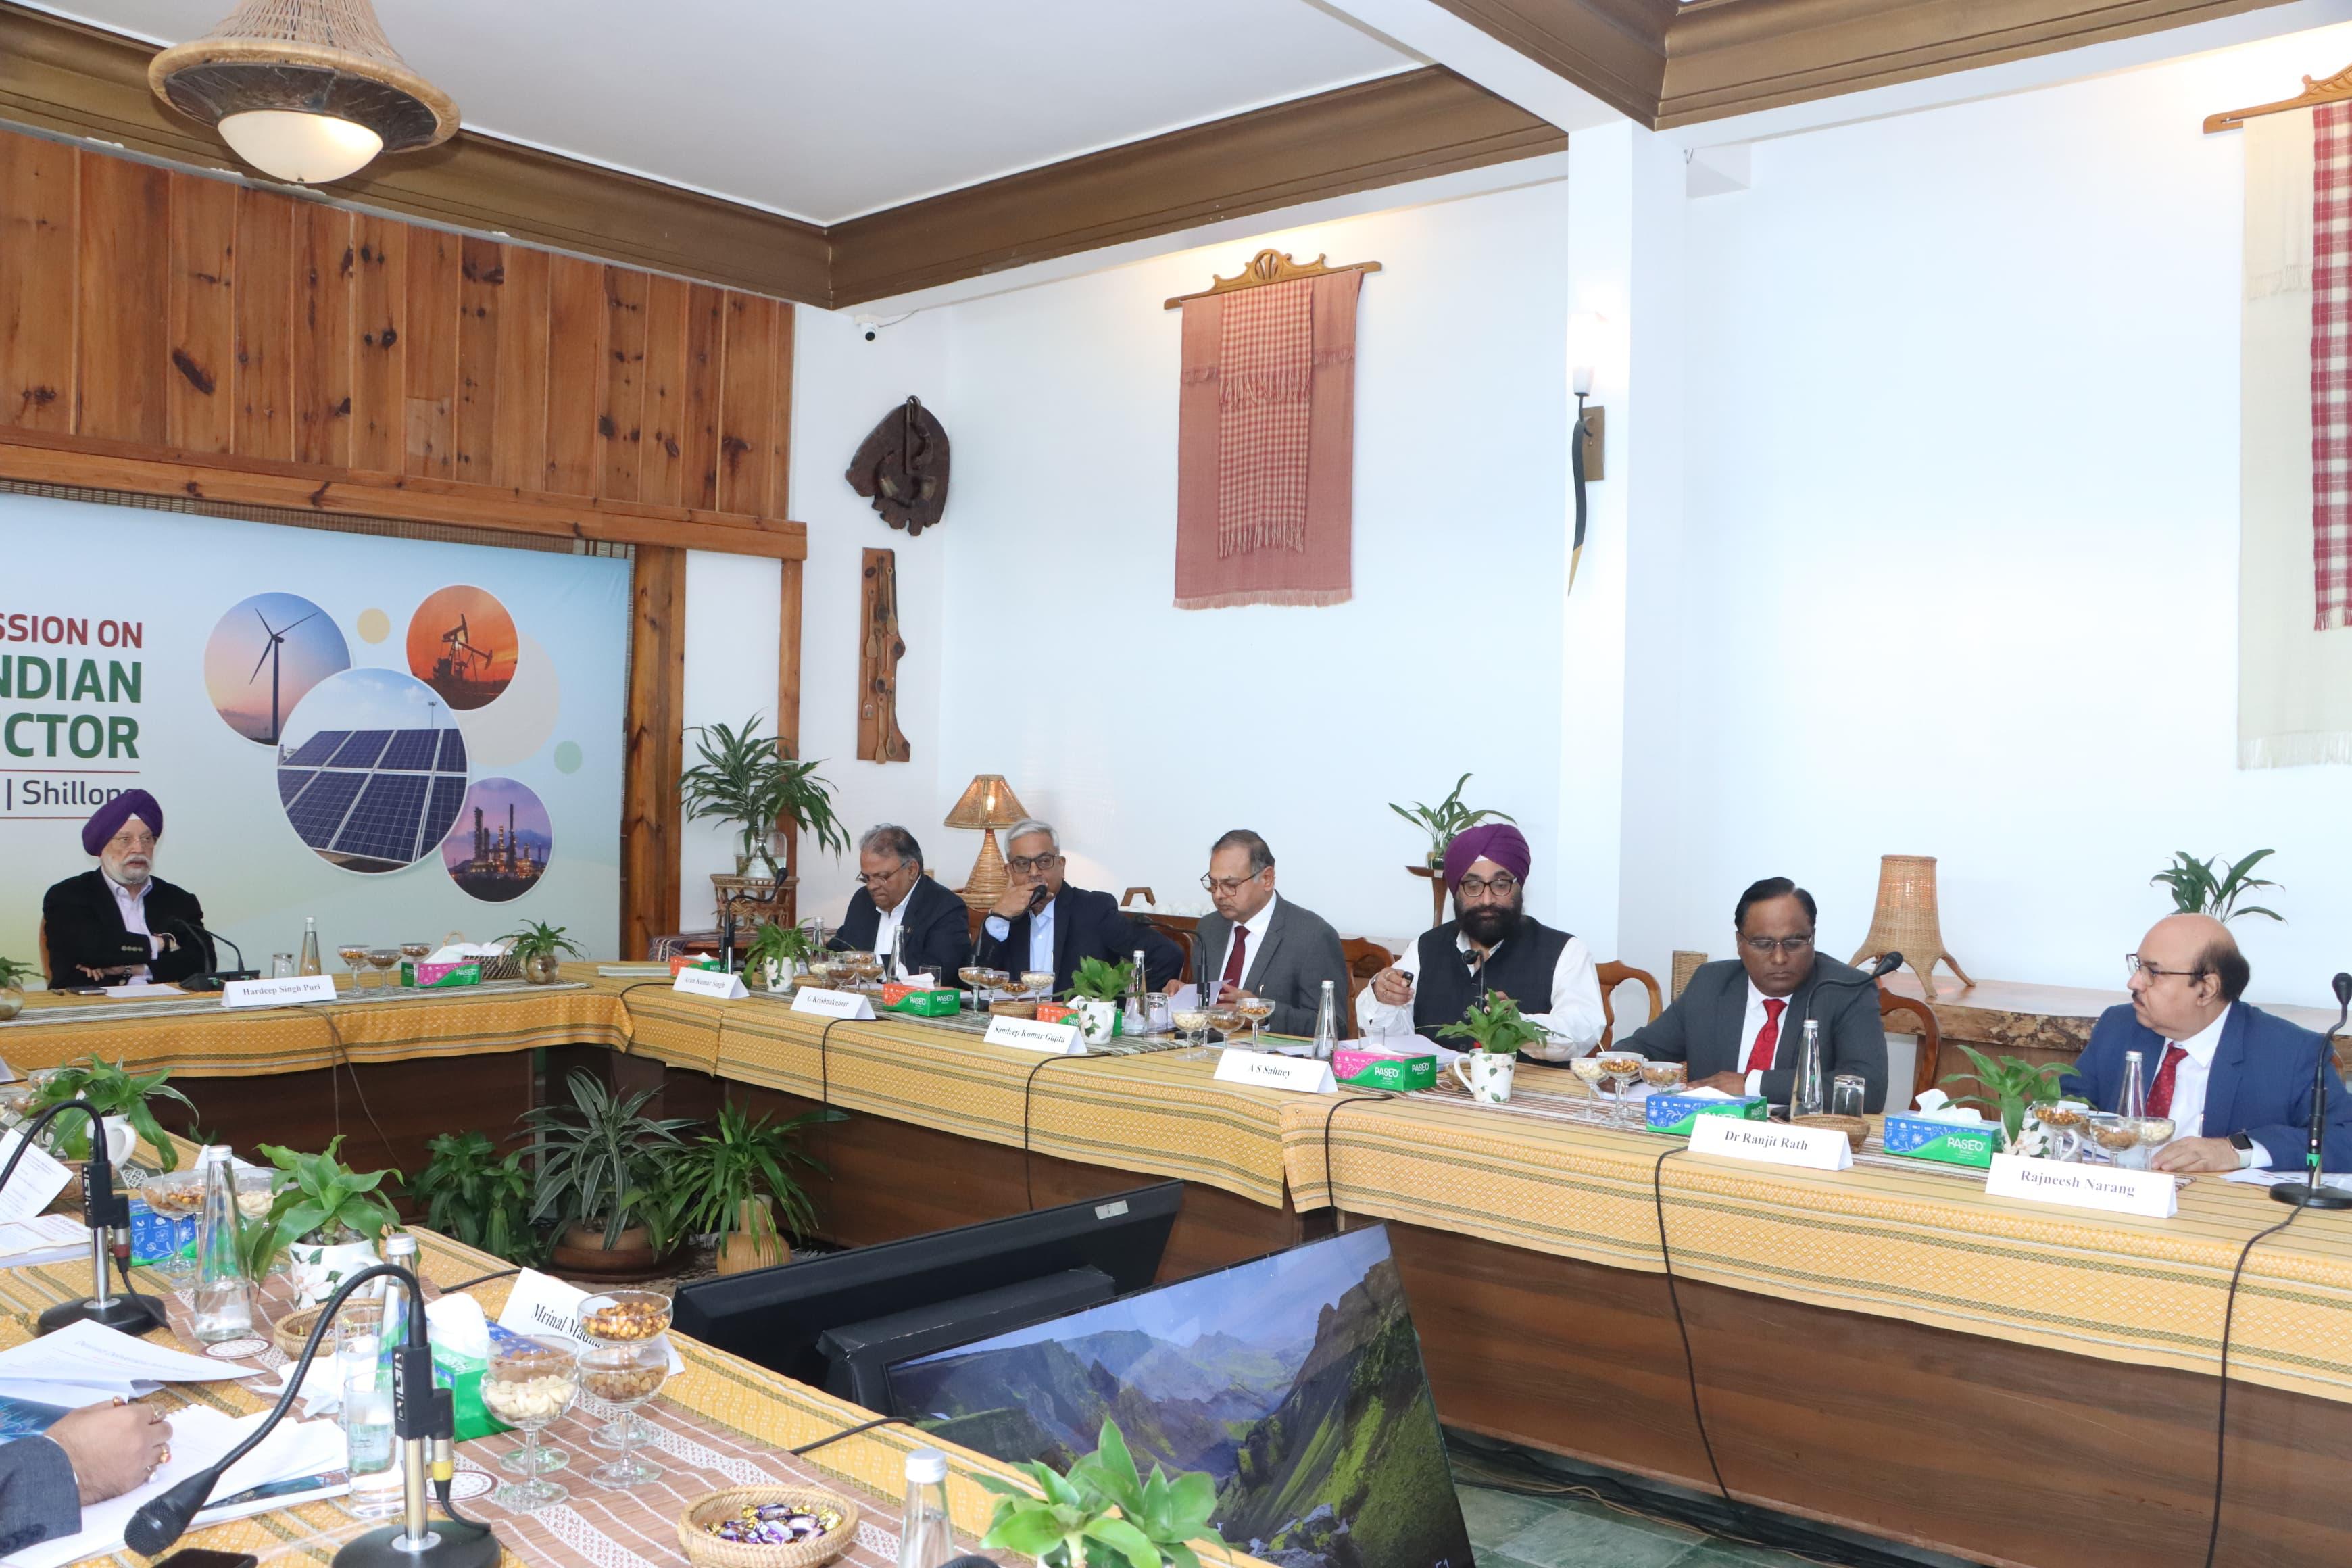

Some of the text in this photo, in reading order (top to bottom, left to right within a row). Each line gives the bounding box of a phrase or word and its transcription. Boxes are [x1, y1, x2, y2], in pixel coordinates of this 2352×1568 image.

[0, 613, 142, 649] SION ON
[4, 712, 140, 759] CTOR
[22, 780, 137, 805] Shillon
[243, 987, 277, 996] Hardeep
[279, 985, 301, 994] Singh
[696, 978, 712, 986] Kumar
[812, 996, 849, 1008] Krishnakumar
[910, 996, 926, 1005] PASEO
[994, 1025, 1065, 1044] Sandeep Kumar Gupta
[1247, 1063, 1292, 1081] A S Sahney
[1375, 1067, 1399, 1078] PASEO
[1412, 1062, 1429, 1073] PASEO
[1725, 1130, 1808, 1150] Dr Ranjit Rath
[1947, 1137, 1984, 1152] PASEO
[2021, 1170, 2135, 1198] Rajneesh Narang
[531, 1303, 568, 1331] Mrinal
